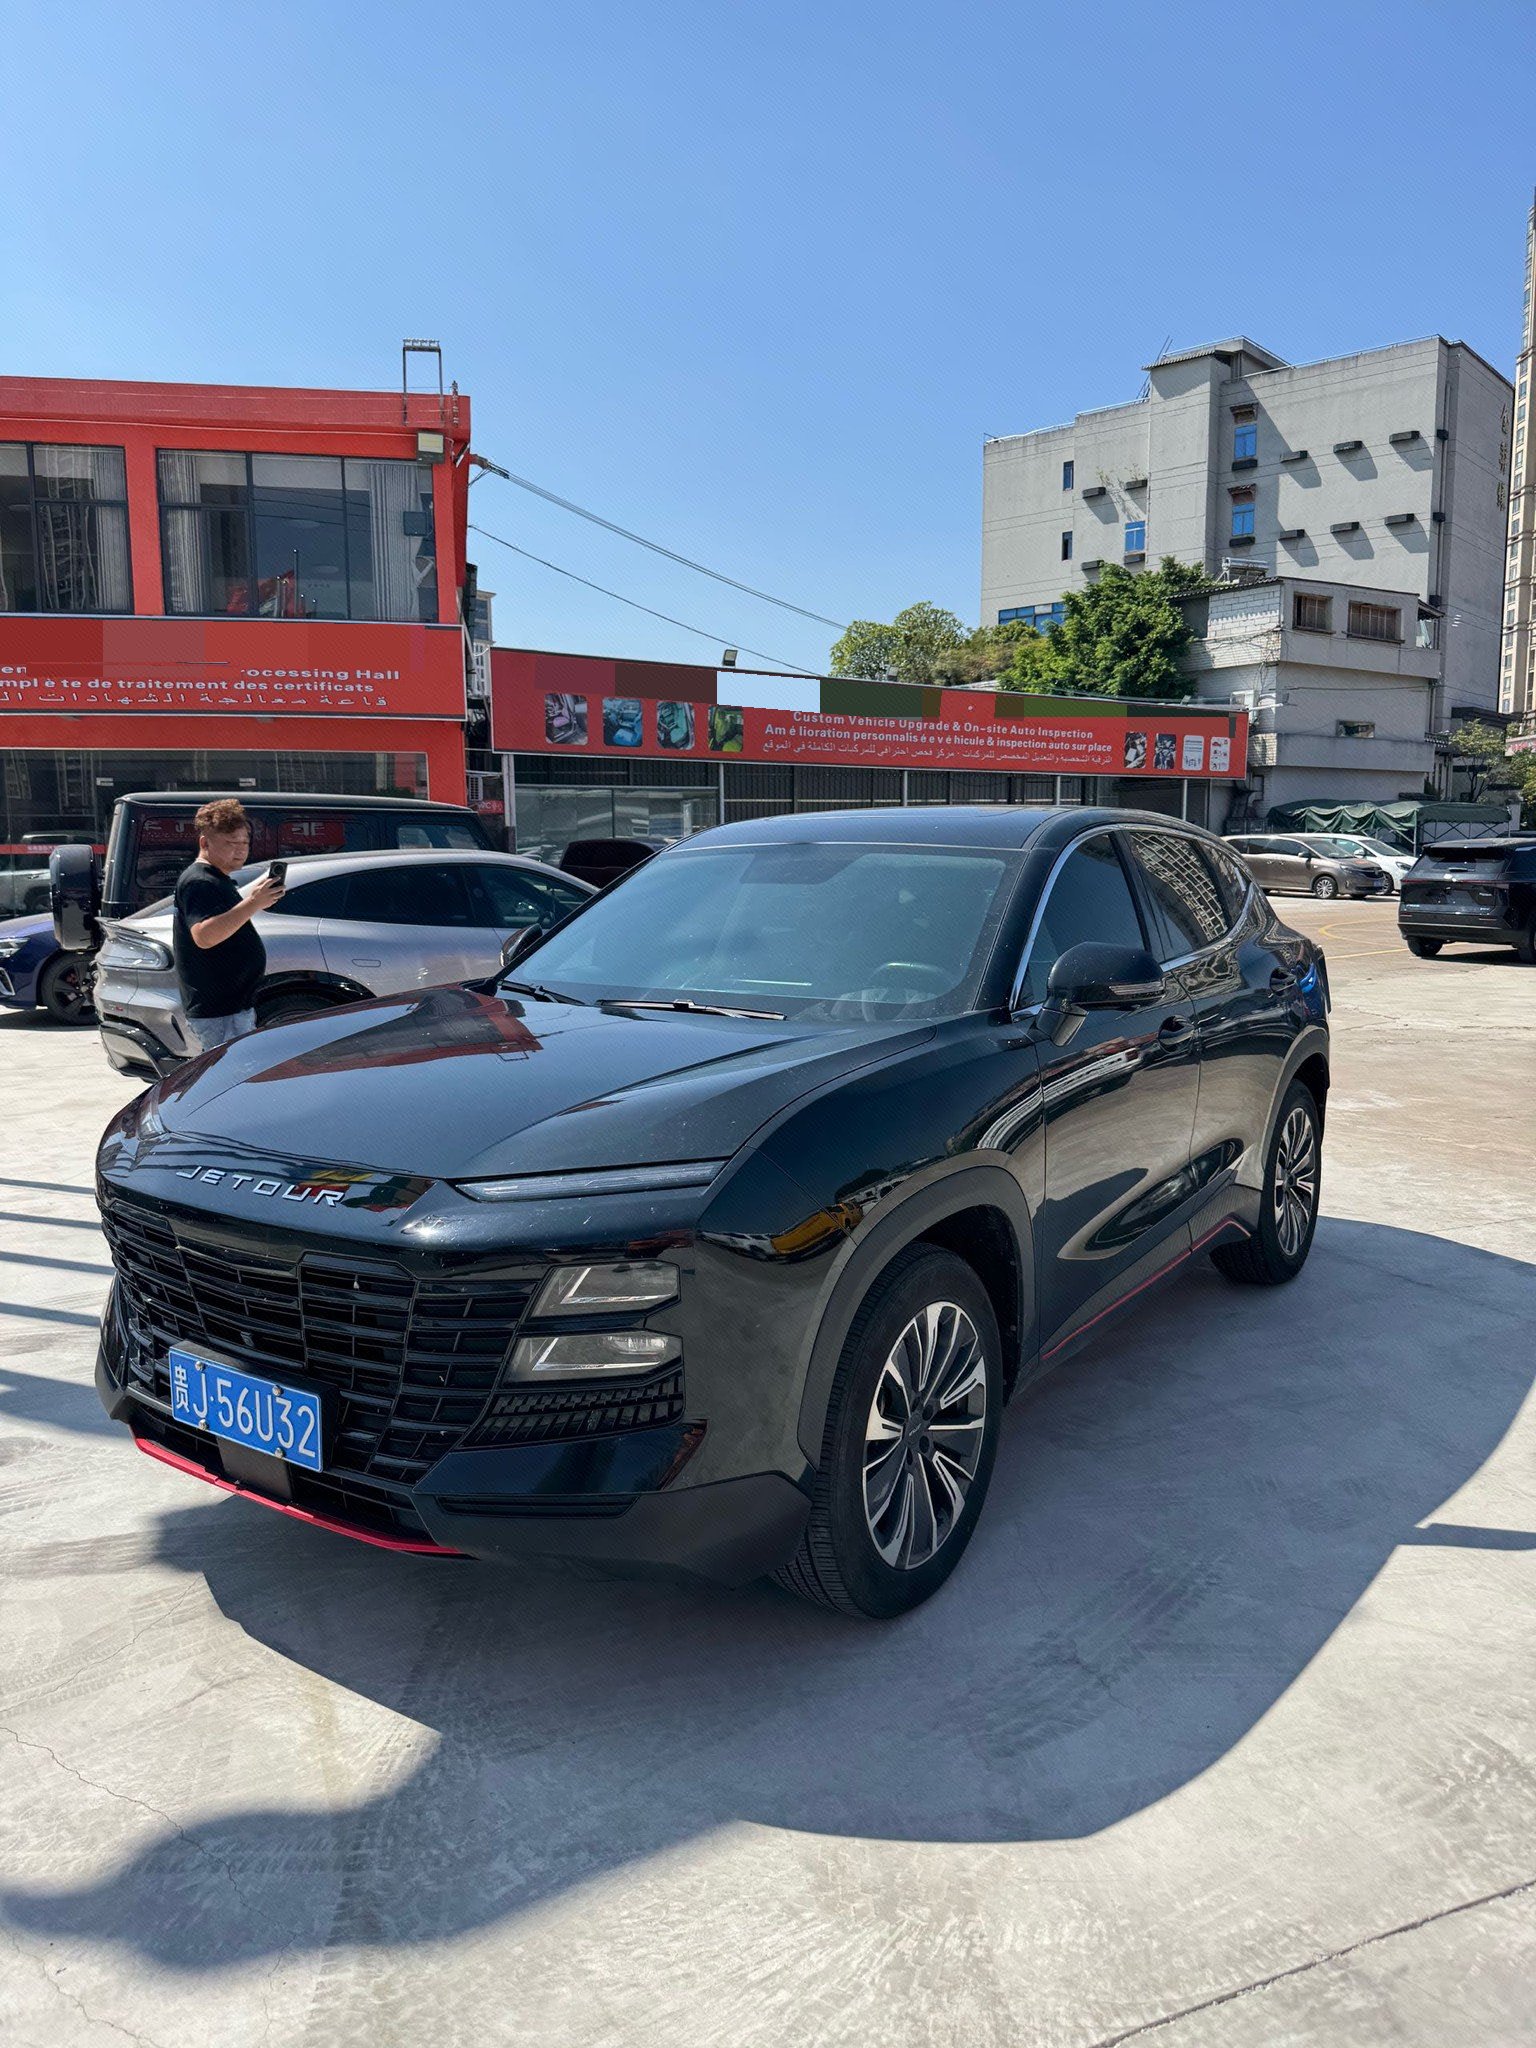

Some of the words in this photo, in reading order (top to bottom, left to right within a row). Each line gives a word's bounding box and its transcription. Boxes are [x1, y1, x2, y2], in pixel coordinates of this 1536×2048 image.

[241, 668, 349, 680] ocessing
[356, 669, 399, 680] Hall
[88, 679, 112, 688] de
[118, 679, 228, 690] traitement
[233, 680, 268, 690] des
[273, 681, 375, 692] certificats
[793, 711, 845, 725] Custom
[849, 715, 896, 728] Vehicle
[899, 719, 949, 732] Upgrade
[952, 721, 960, 731] &
[964, 722, 1008, 734] On-site
[1010, 725, 1036, 735] Auto
[1038, 727, 1093, 739] Inspection
[987, 737, 994, 746] &
[997, 737, 1047, 749] inspection
[1048, 740, 1070, 750] auto
[1072, 743, 1086, 751] sur
[1087, 742, 1112, 753] place
[176, 1166, 346, 1207] JETOUR
